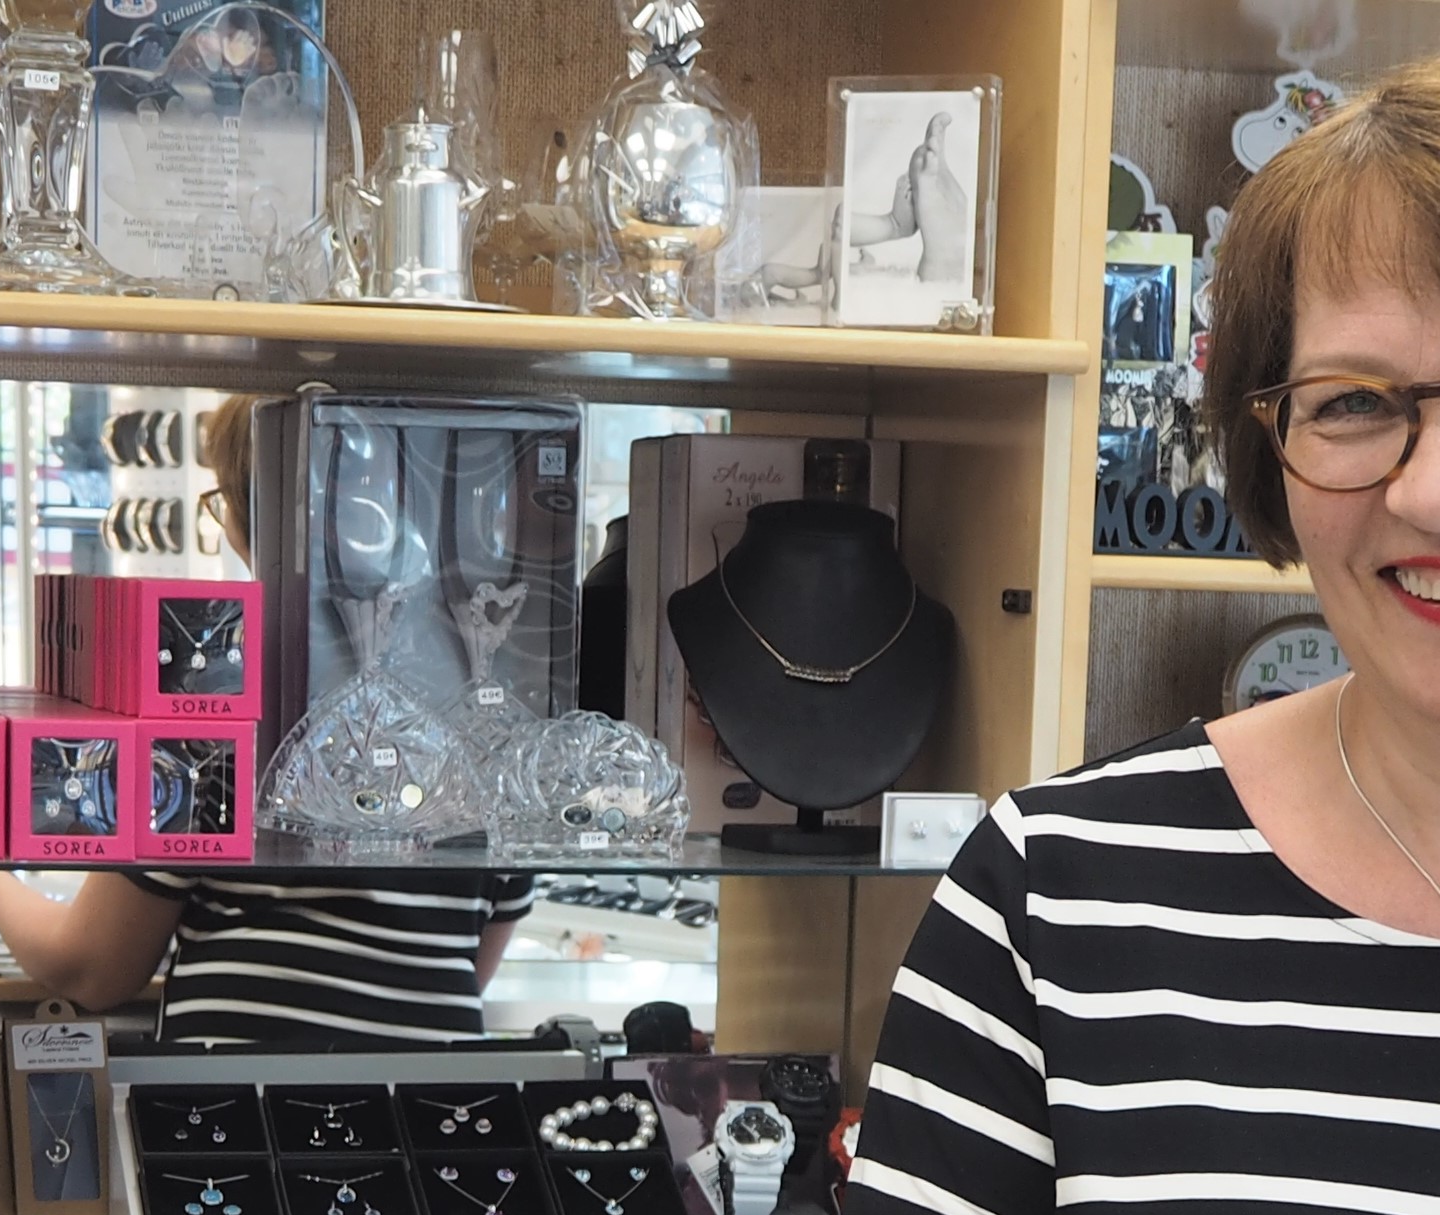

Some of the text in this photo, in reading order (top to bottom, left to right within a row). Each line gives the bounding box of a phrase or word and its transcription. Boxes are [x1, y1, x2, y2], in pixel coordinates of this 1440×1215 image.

[1299, 639, 1320, 659] 12
[171, 700, 232, 713] SOREA
[43, 841, 106, 856] SOREA
[163, 839, 224, 853] SOREA
